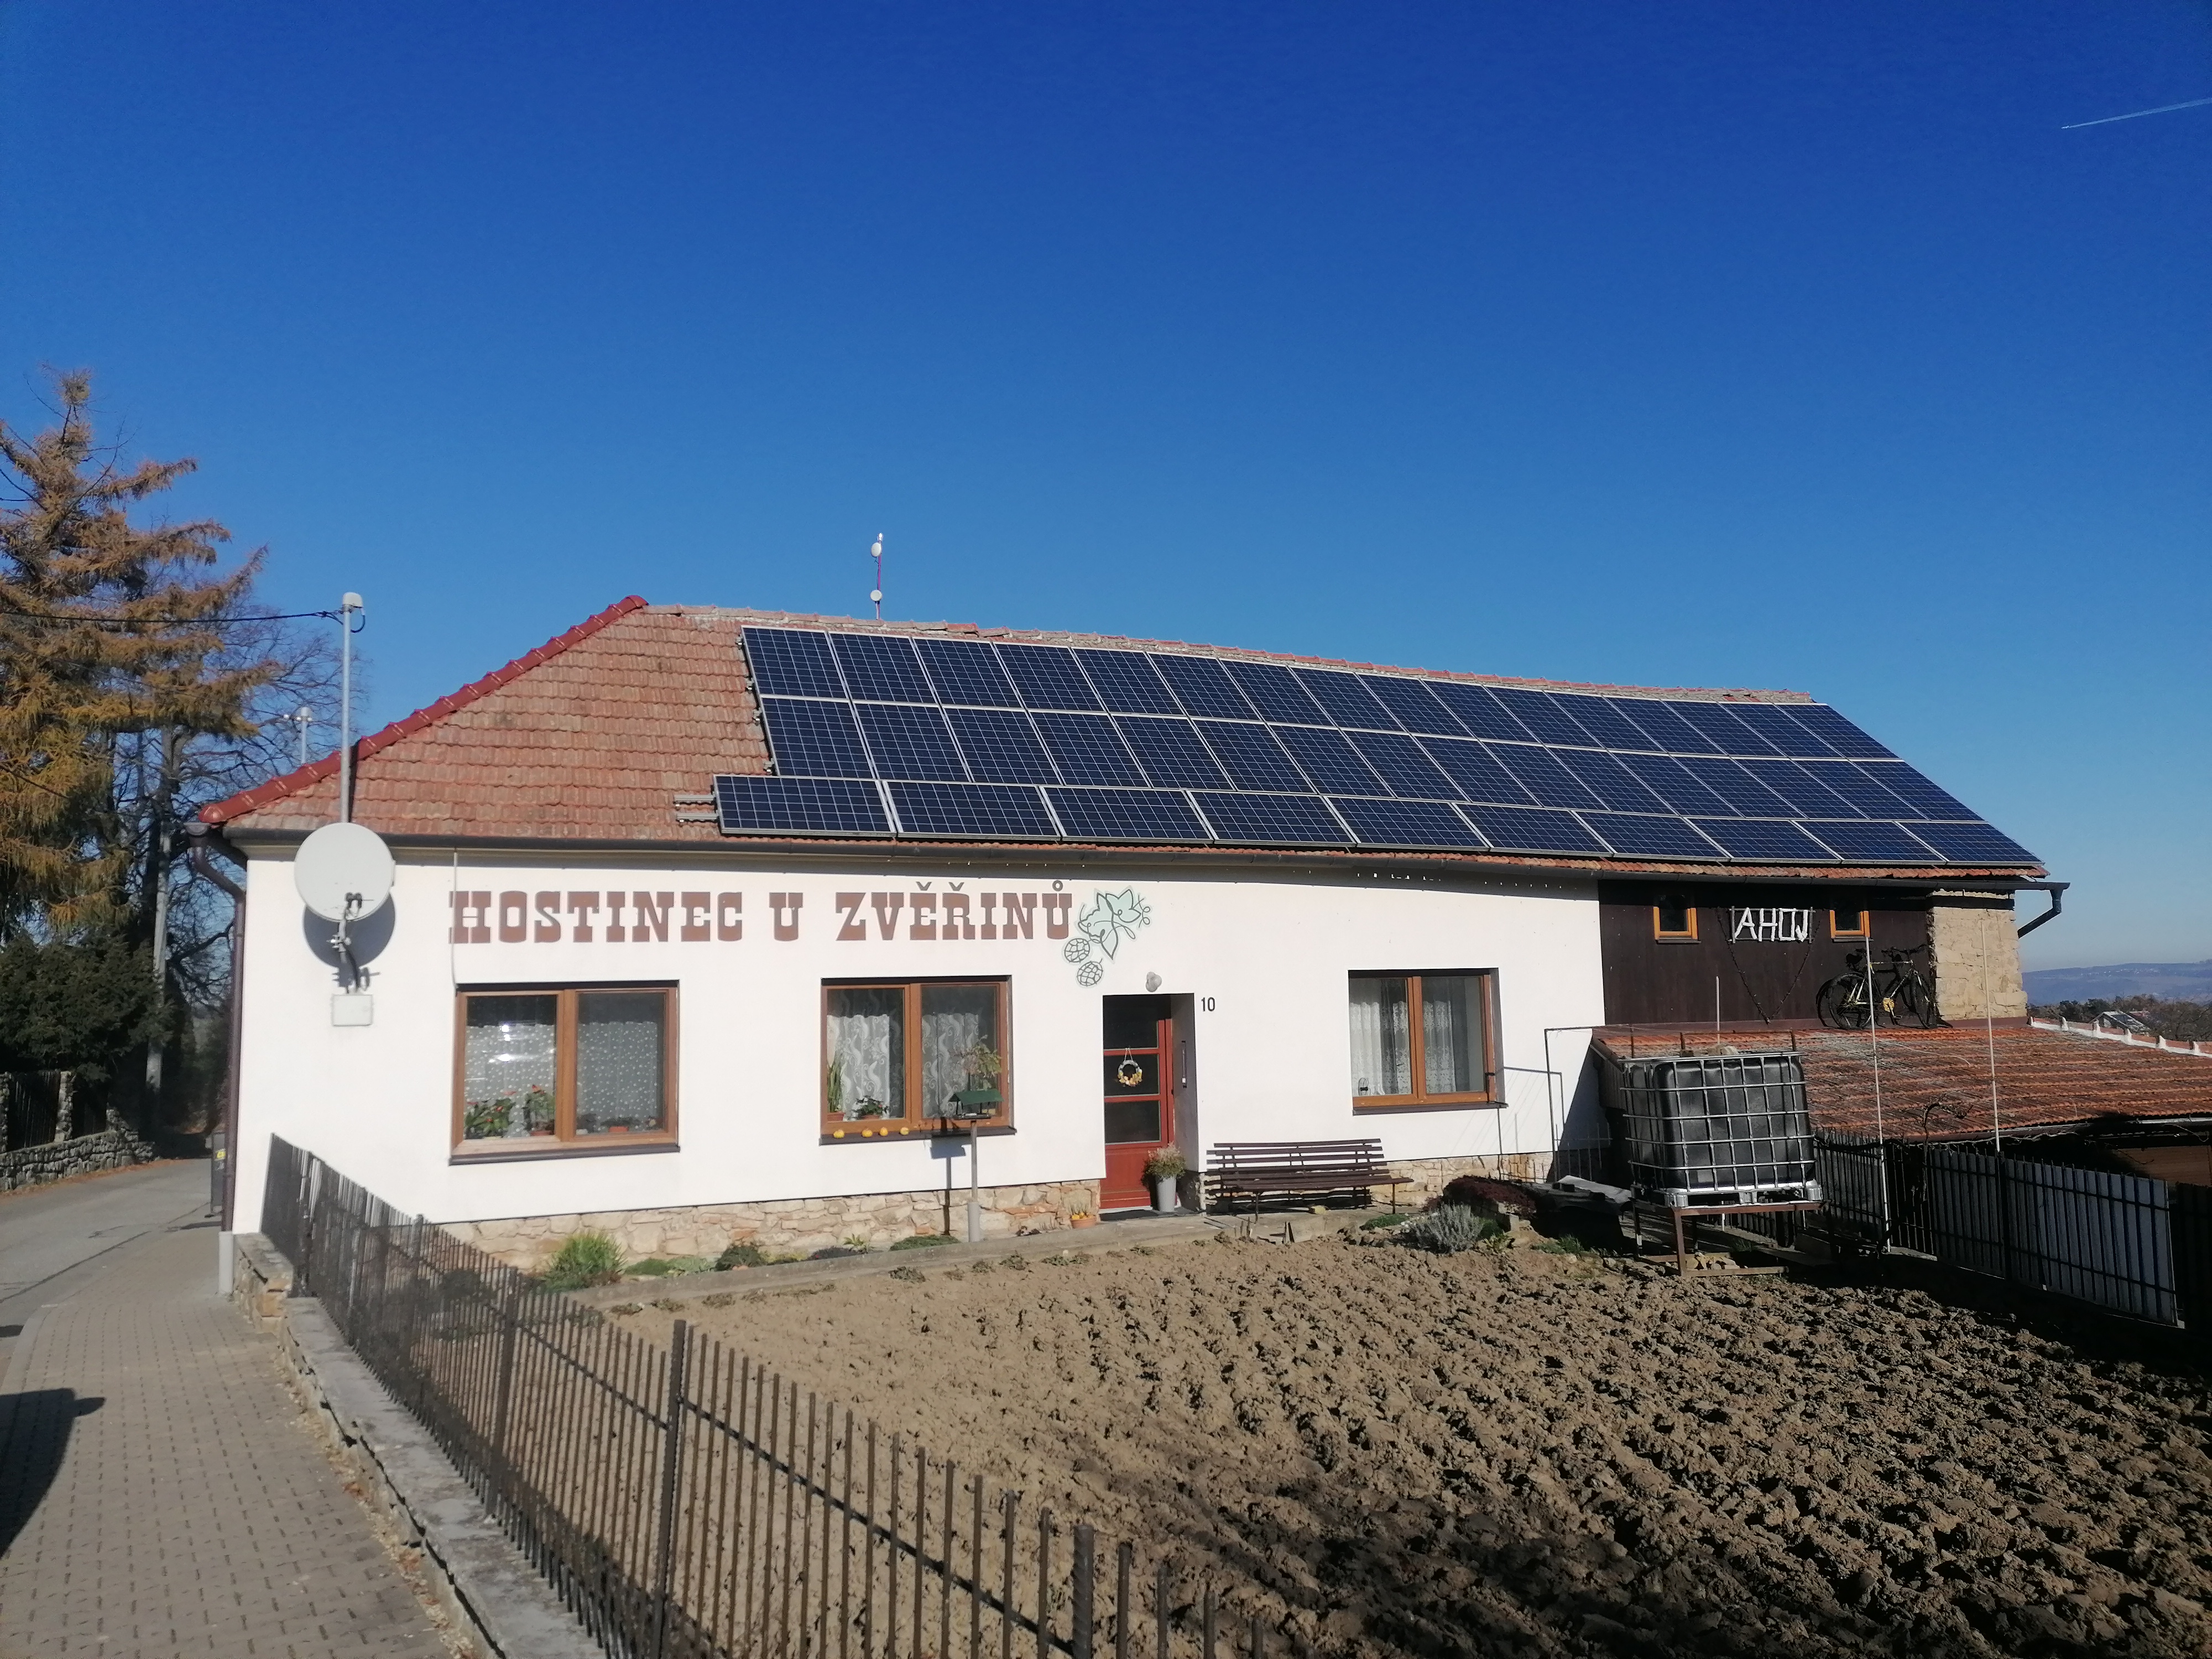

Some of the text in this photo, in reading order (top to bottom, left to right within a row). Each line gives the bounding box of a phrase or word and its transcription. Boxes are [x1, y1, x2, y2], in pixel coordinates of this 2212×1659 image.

[448, 880, 1074, 944] HOSTINEC U ZVĚŘINŮ
[1735, 907, 1808, 942] AHOJ
[1201, 997, 1215, 1011] 10
